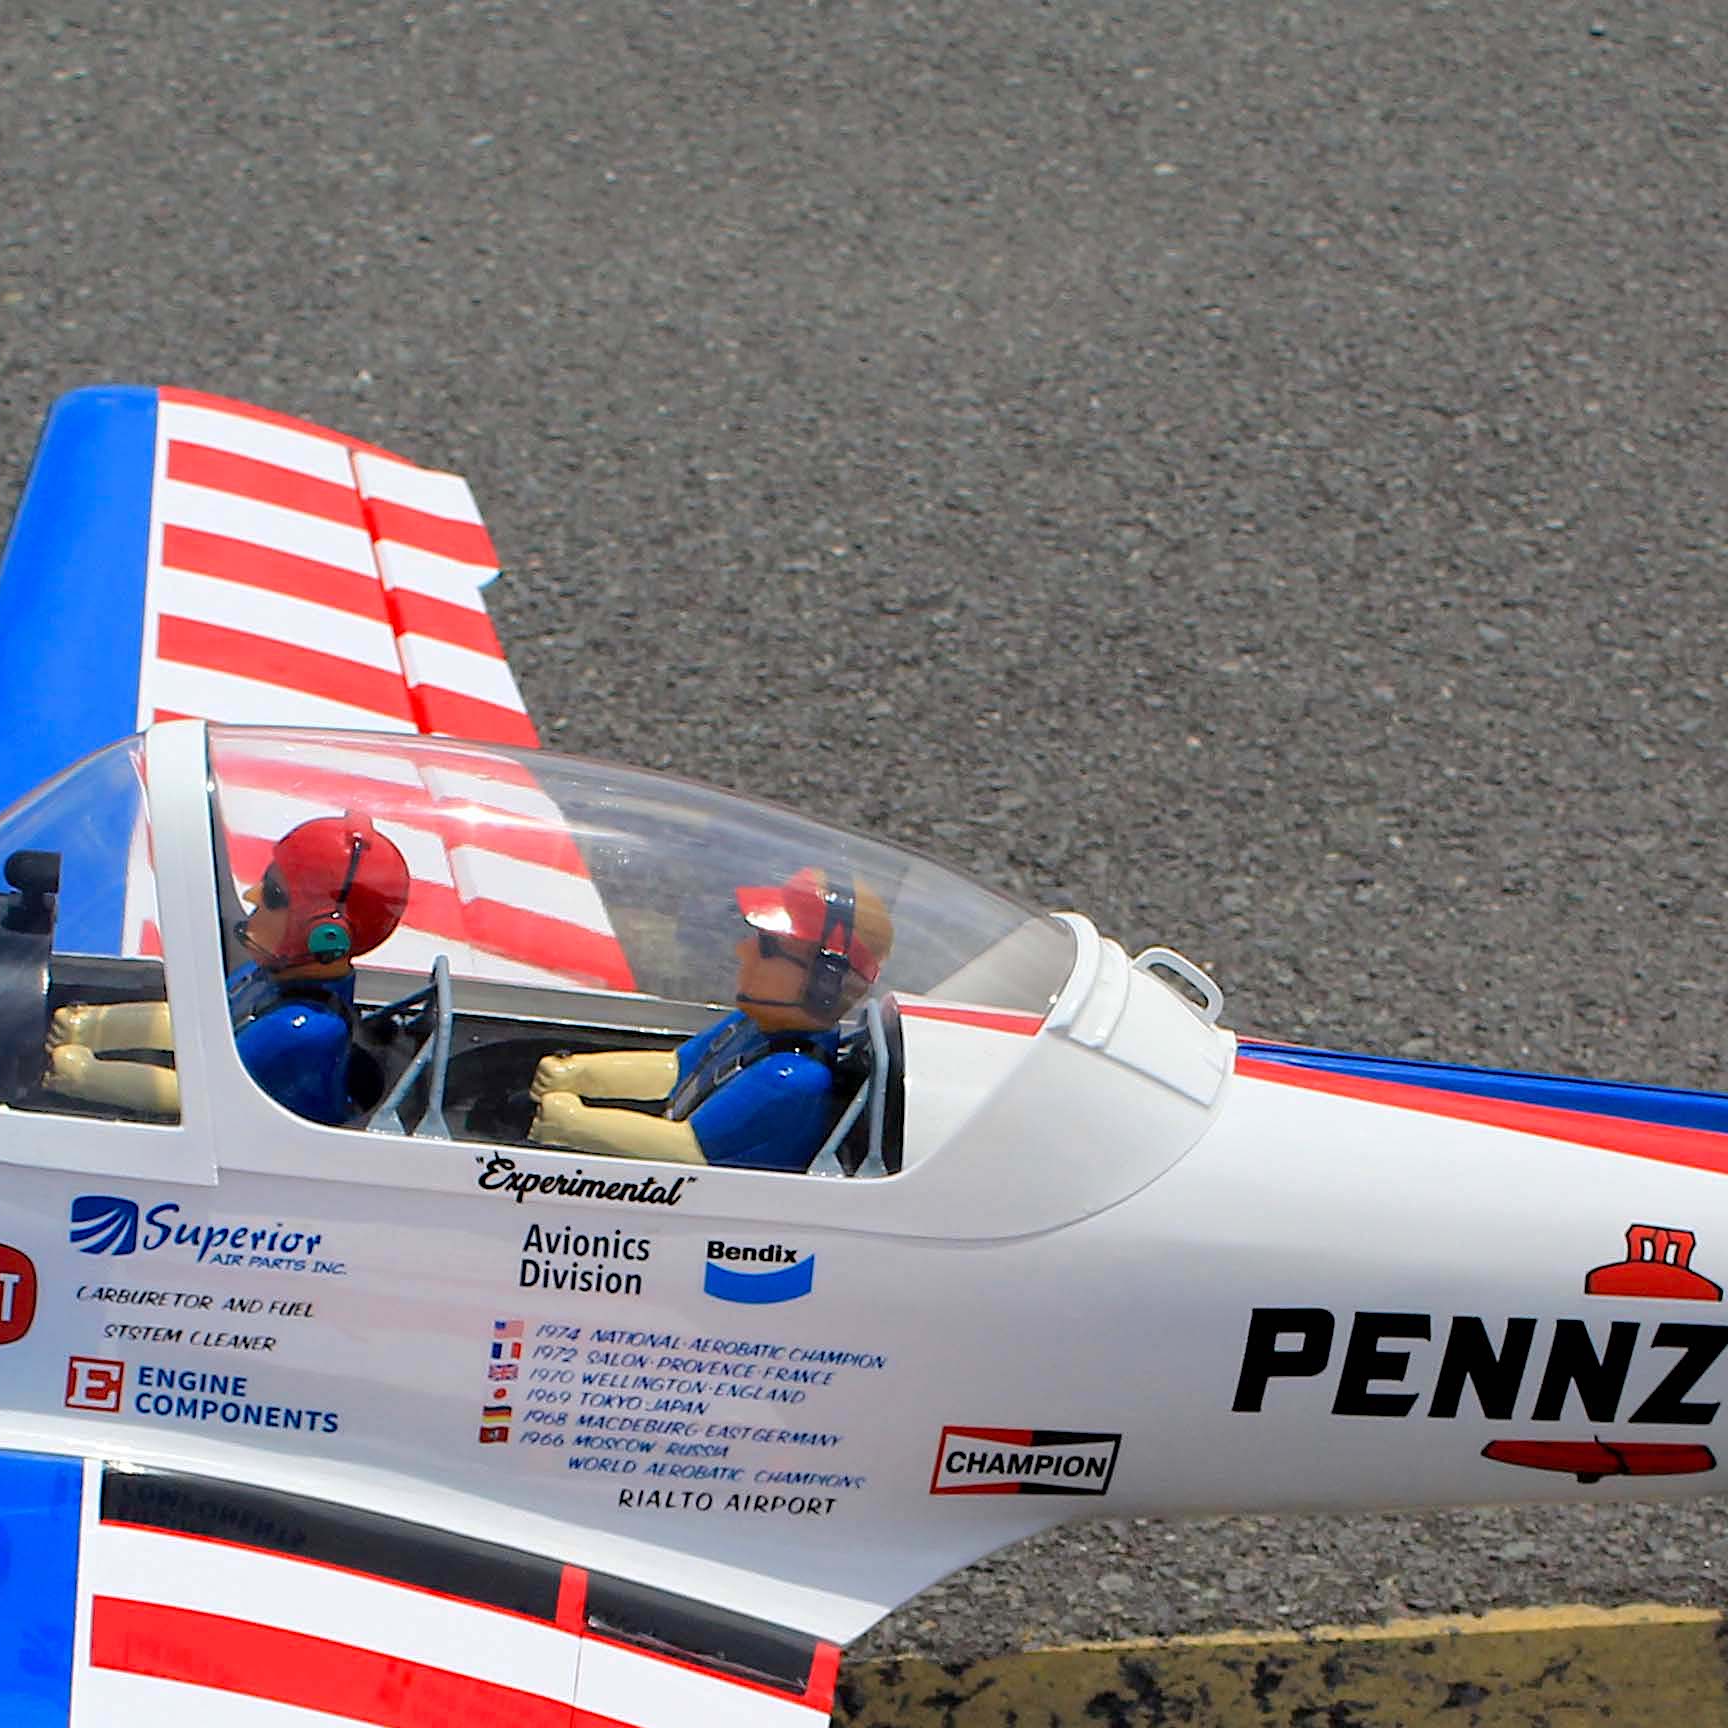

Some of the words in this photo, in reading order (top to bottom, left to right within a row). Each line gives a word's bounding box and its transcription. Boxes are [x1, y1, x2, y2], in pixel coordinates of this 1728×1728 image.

[143, 1203, 322, 1262] Superior
[523, 1224, 651, 1261] Avionics
[209, 1253, 241, 1267] AIR
[247, 1256, 306, 1272] PARTS
[311, 1260, 348, 1276] INC.
[707, 1240, 798, 1264] Bendix
[520, 1259, 642, 1295] Division
[76, 1285, 213, 1310] CARBURETOR
[223, 1297, 264, 1314] AND
[268, 1301, 315, 1318] FUEL
[189, 1330, 277, 1352] CLEANER
[531, 1345, 578, 1362] 1972
[536, 1324, 581, 1340] 1974
[788, 1348, 888, 1369] CHAMPION
[139, 1365, 248, 1397] ENGINE
[529, 1367, 575, 1384] 1970
[526, 1388, 572, 1402] 1969
[135, 1393, 339, 1433] COMPONENTS
[523, 1409, 568, 1426] 1968
[520, 1431, 566, 1448] 1966
[573, 1434, 658, 1454] MOSCOW
[568, 1456, 637, 1474] WORLD
[645, 1463, 745, 1482] AEROBATIC
[754, 1469, 867, 1489] CHAMPIONS
[946, 1451, 1107, 1478] CHAMPION
[618, 1488, 713, 1511] RIALTO
[724, 1493, 838, 1515] AIRPORT
